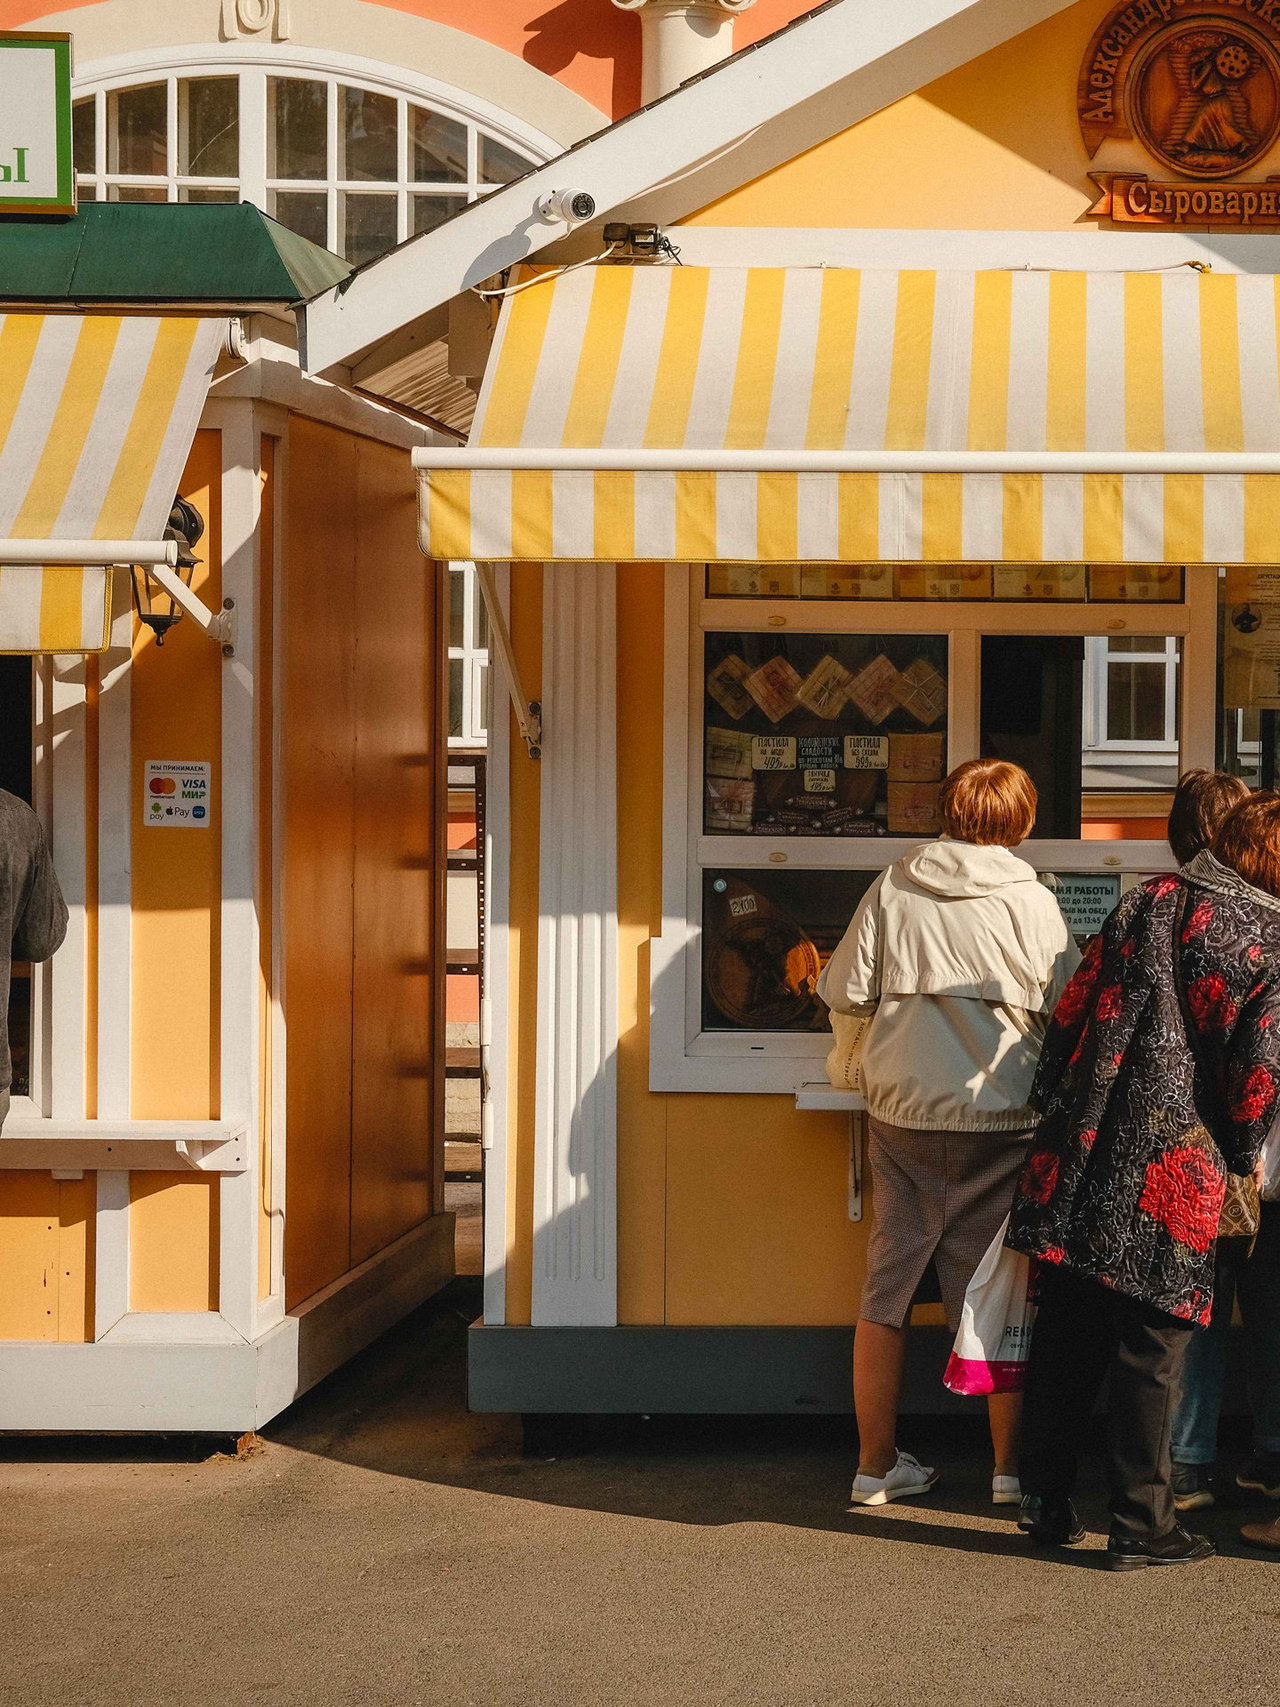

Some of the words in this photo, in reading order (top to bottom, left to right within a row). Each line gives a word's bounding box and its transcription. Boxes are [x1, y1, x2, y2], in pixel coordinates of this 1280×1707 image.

[757, 738, 789, 747] ПАСТИЛА
[850, 738, 881, 748] ПАСТИЛА
[182, 780, 206, 789] VISA
[182, 791, 206, 799] МИР
[175, 807, 190, 819] Pay
[1051, 886, 1072, 895] ЕМЯ
[1075, 886, 1114, 896] РАБОТЫ
